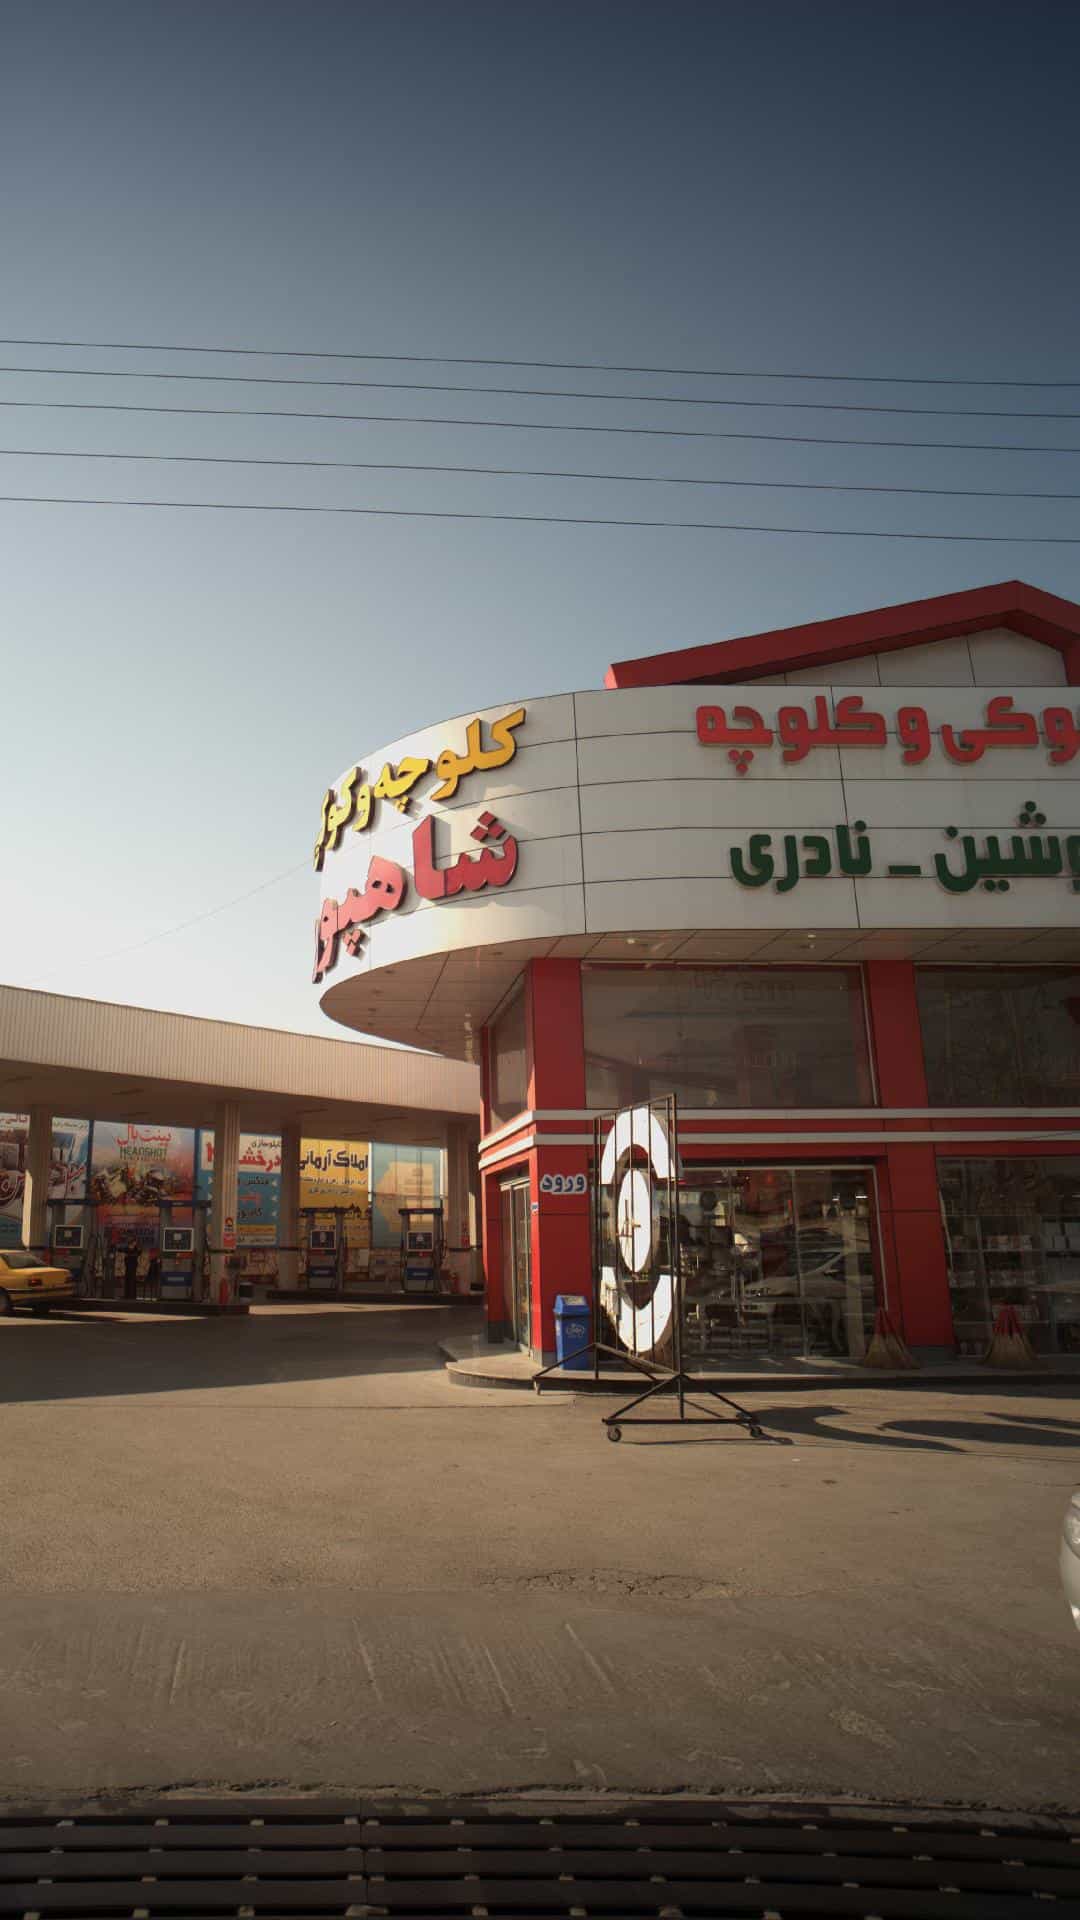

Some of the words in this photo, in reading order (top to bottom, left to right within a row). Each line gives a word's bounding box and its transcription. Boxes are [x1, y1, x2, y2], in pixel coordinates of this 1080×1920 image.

[374, 707, 526, 814] کلوچه
[696, 695, 887, 775] کلوچه
[897, 706, 931, 764] و
[941, 695, 1080, 764] وکی
[730, 820, 872, 893] نادری
[333, 1150, 368, 1171] املاک
[541, 1174, 587, 1195] ورود
